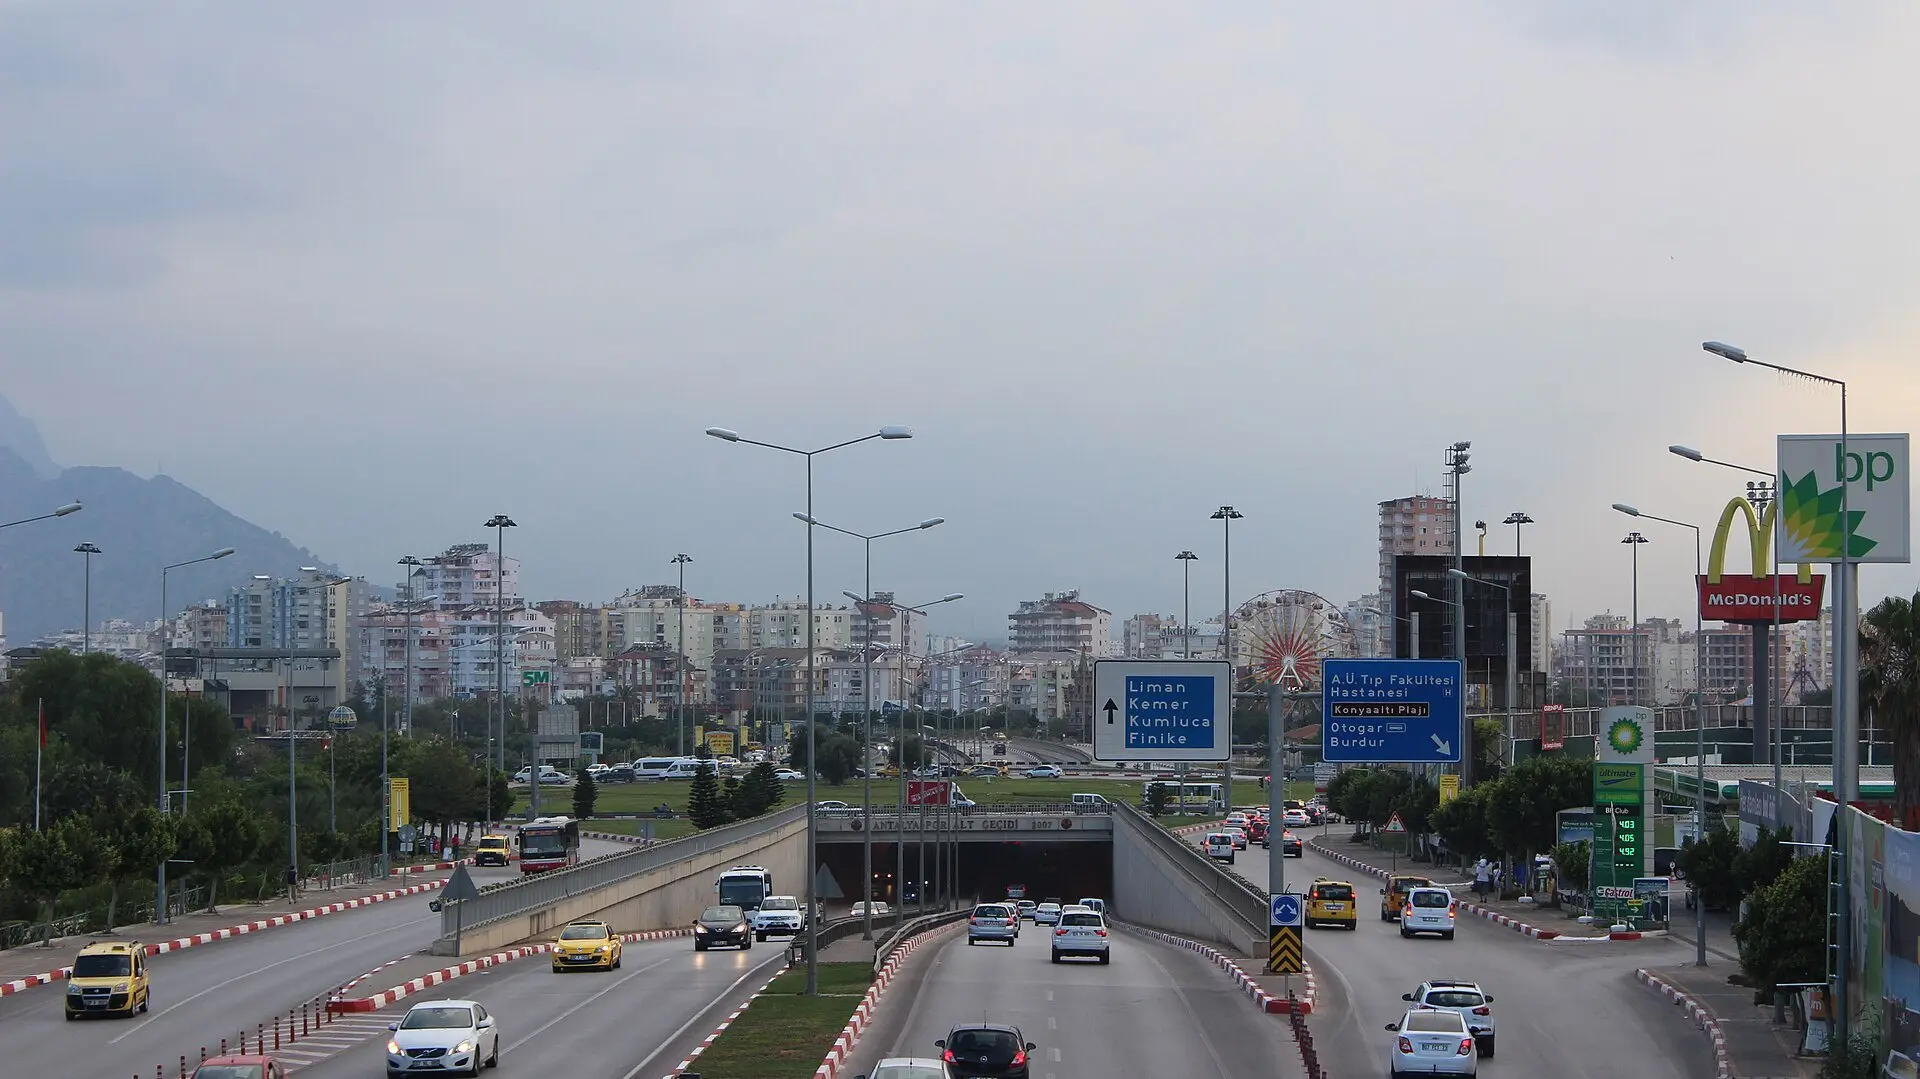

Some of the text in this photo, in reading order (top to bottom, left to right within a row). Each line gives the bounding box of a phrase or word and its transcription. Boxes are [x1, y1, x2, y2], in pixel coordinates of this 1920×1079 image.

[1836, 443, 1894, 492] bp
[1708, 593, 1812, 606] McDonald's
[522, 671, 549, 687] 5M
[1390, 674, 1455, 685] Fakültesi
[1129, 680, 1186, 693] Liman
[1331, 687, 1409, 698] Hastanesi
[1129, 697, 1189, 710] Kemer
[1334, 705, 1395, 716] Konyaaltı
[1635, 711, 1647, 720] bp
[1129, 715, 1210, 727] Kumluca
[1331, 722, 1383, 734] Otogar
[1129, 732, 1187, 744] Finike
[1330, 736, 1385, 748] Burdur
[1619, 820, 1635, 829] 4.03
[1619, 834, 1635, 843] 4.05
[1619, 847, 1635, 856] 4.92
[1605, 888, 1634, 898] Castrol
